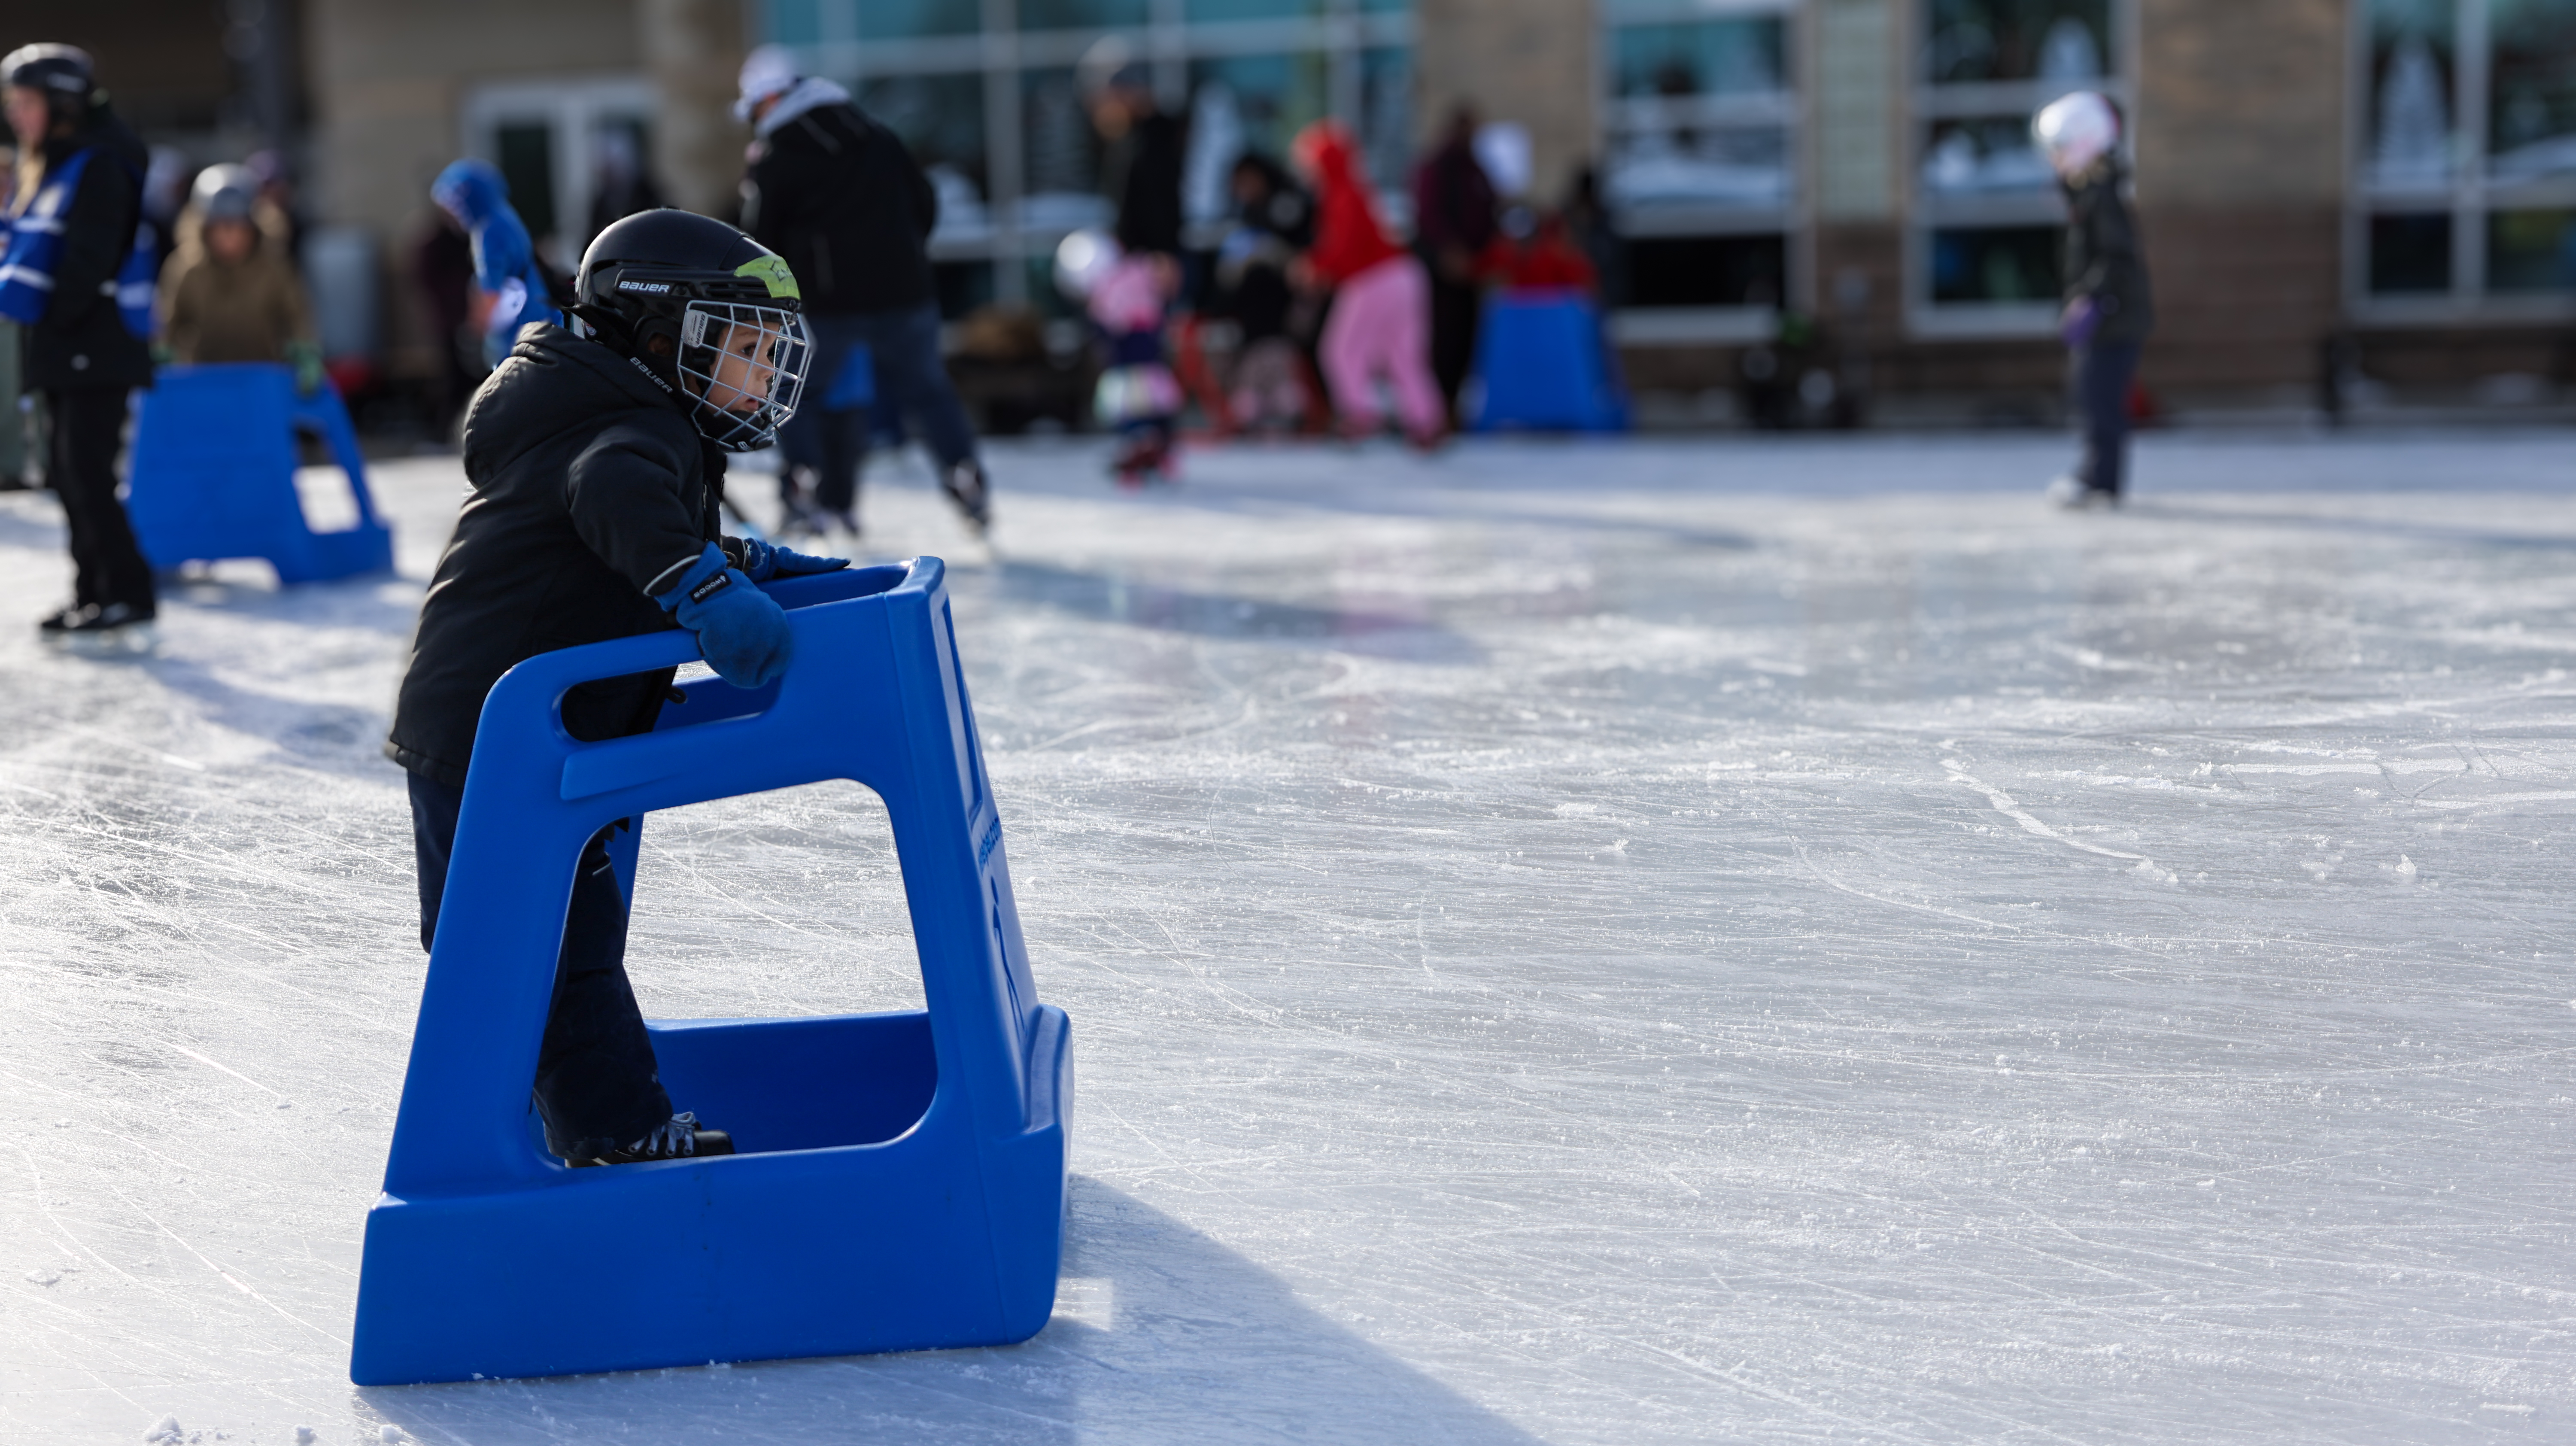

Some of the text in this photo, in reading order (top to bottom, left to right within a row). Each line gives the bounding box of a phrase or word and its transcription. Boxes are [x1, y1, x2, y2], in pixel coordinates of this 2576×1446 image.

[619, 281, 670, 292] BAUER
[695, 313, 705, 344] BAUER
[629, 356, 673, 393] BAUER
[694, 578, 722, 598] WOODS
